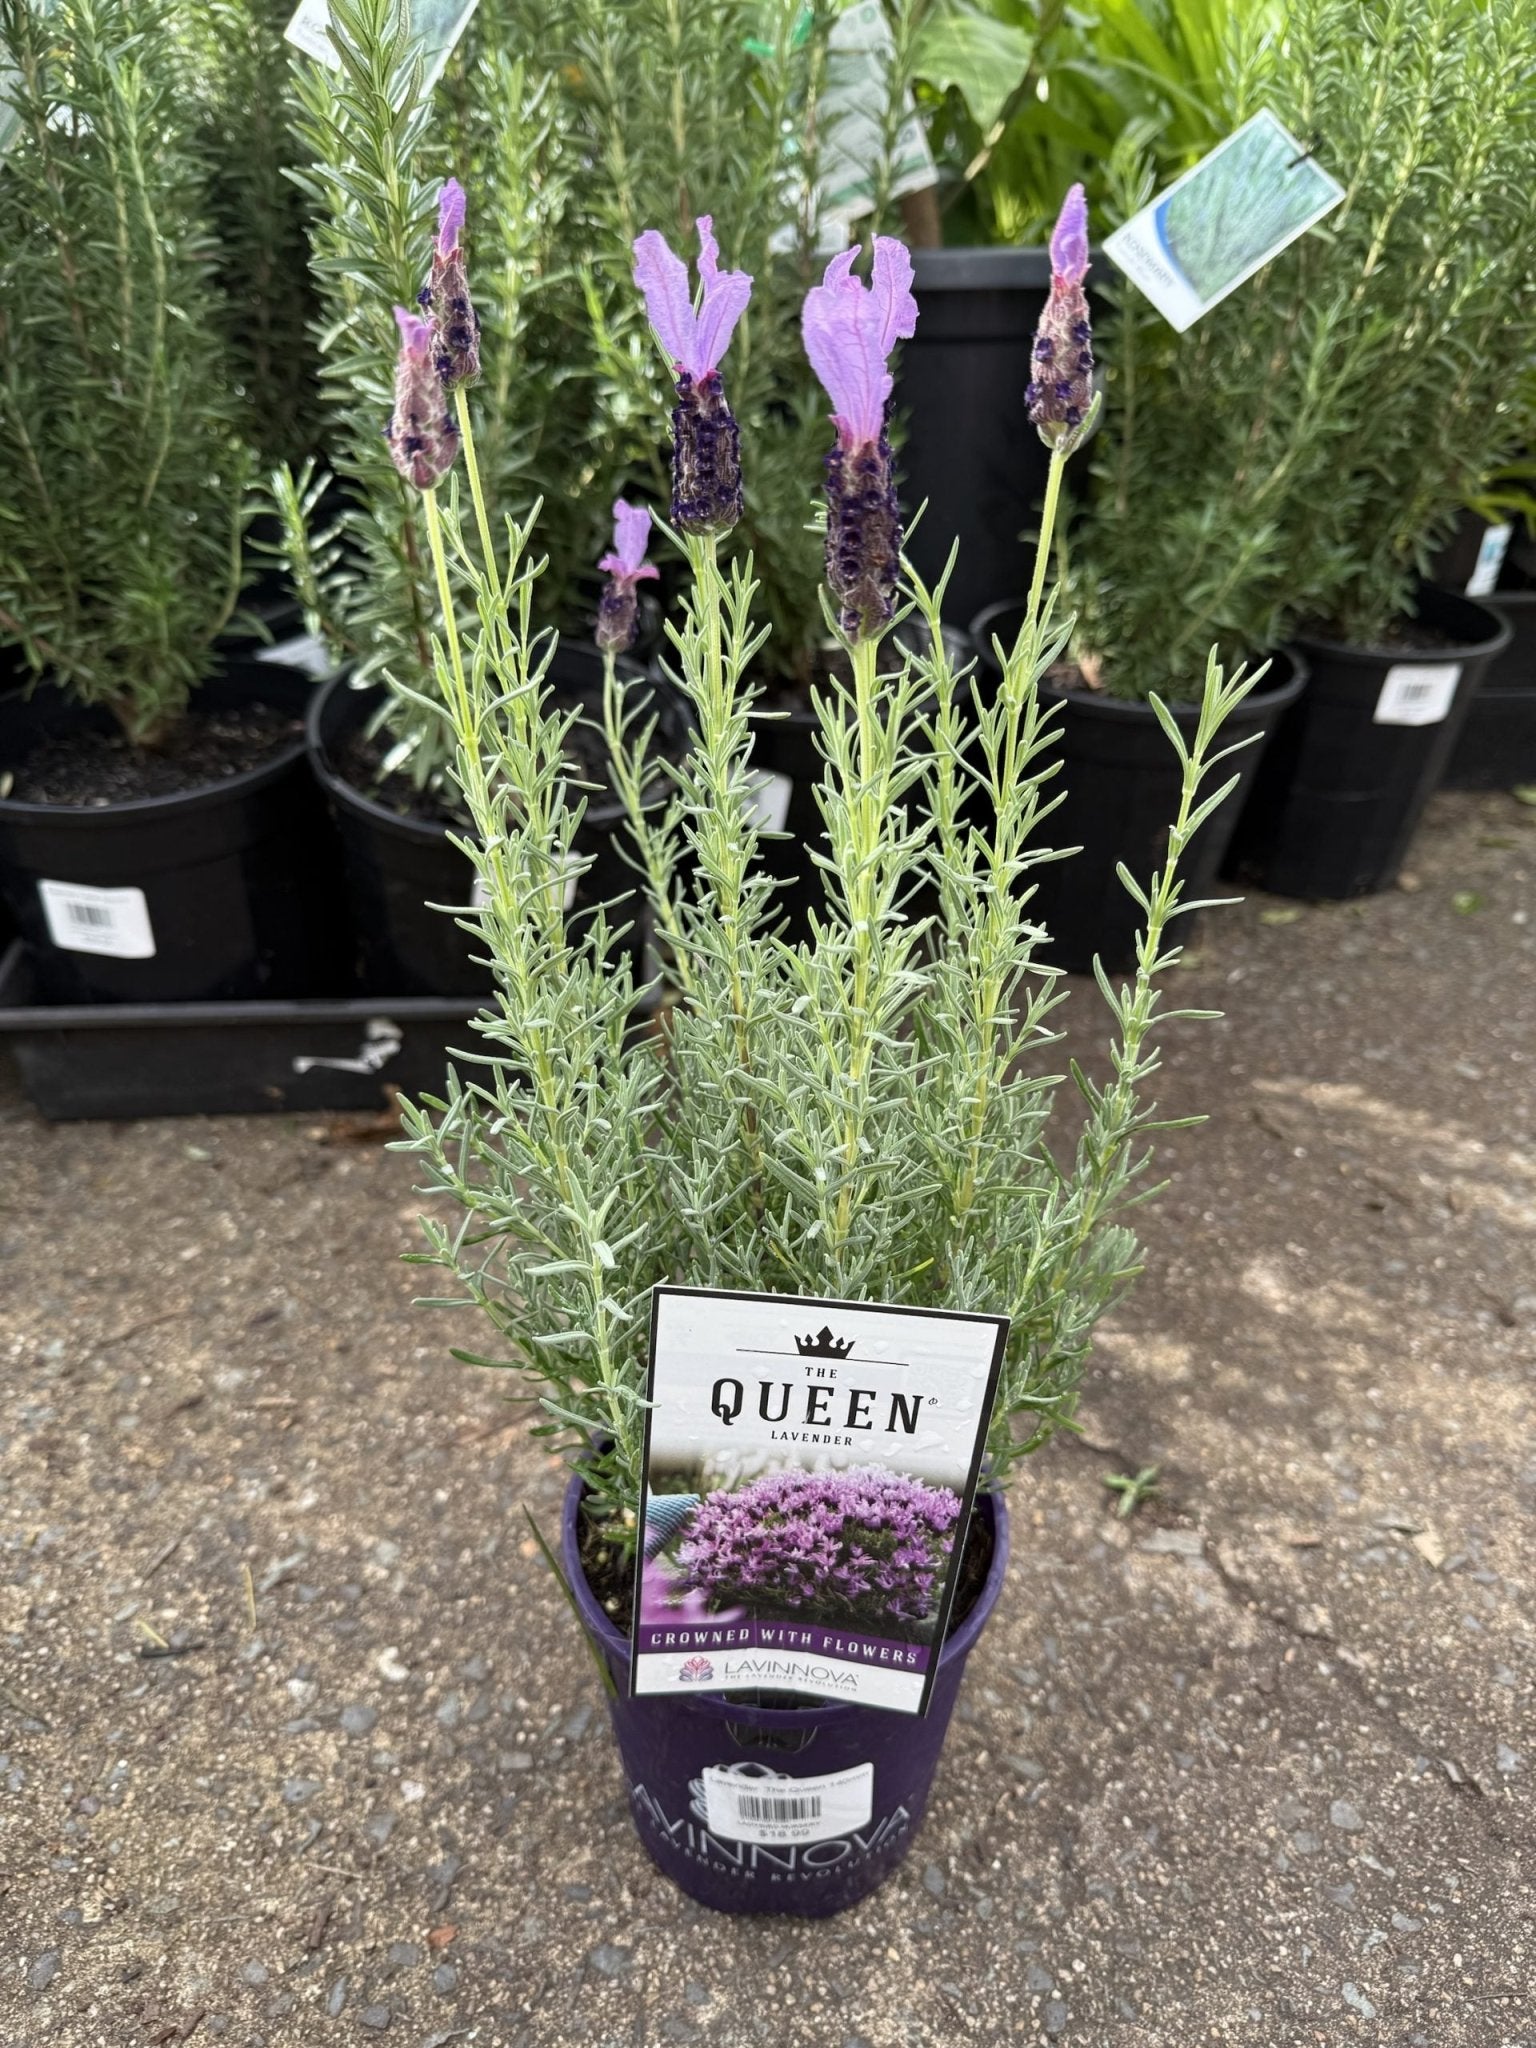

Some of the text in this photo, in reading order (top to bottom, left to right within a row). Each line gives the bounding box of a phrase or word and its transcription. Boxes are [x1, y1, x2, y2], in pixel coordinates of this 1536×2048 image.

[805, 1366, 838, 1379] THE
[711, 1378, 924, 1434] QUEEN
[771, 1430, 853, 1446] LAVENDER
[651, 1628, 918, 1664] CROWNED WITH FLOWERS
[724, 1659, 858, 1686] LAVINNOVA
